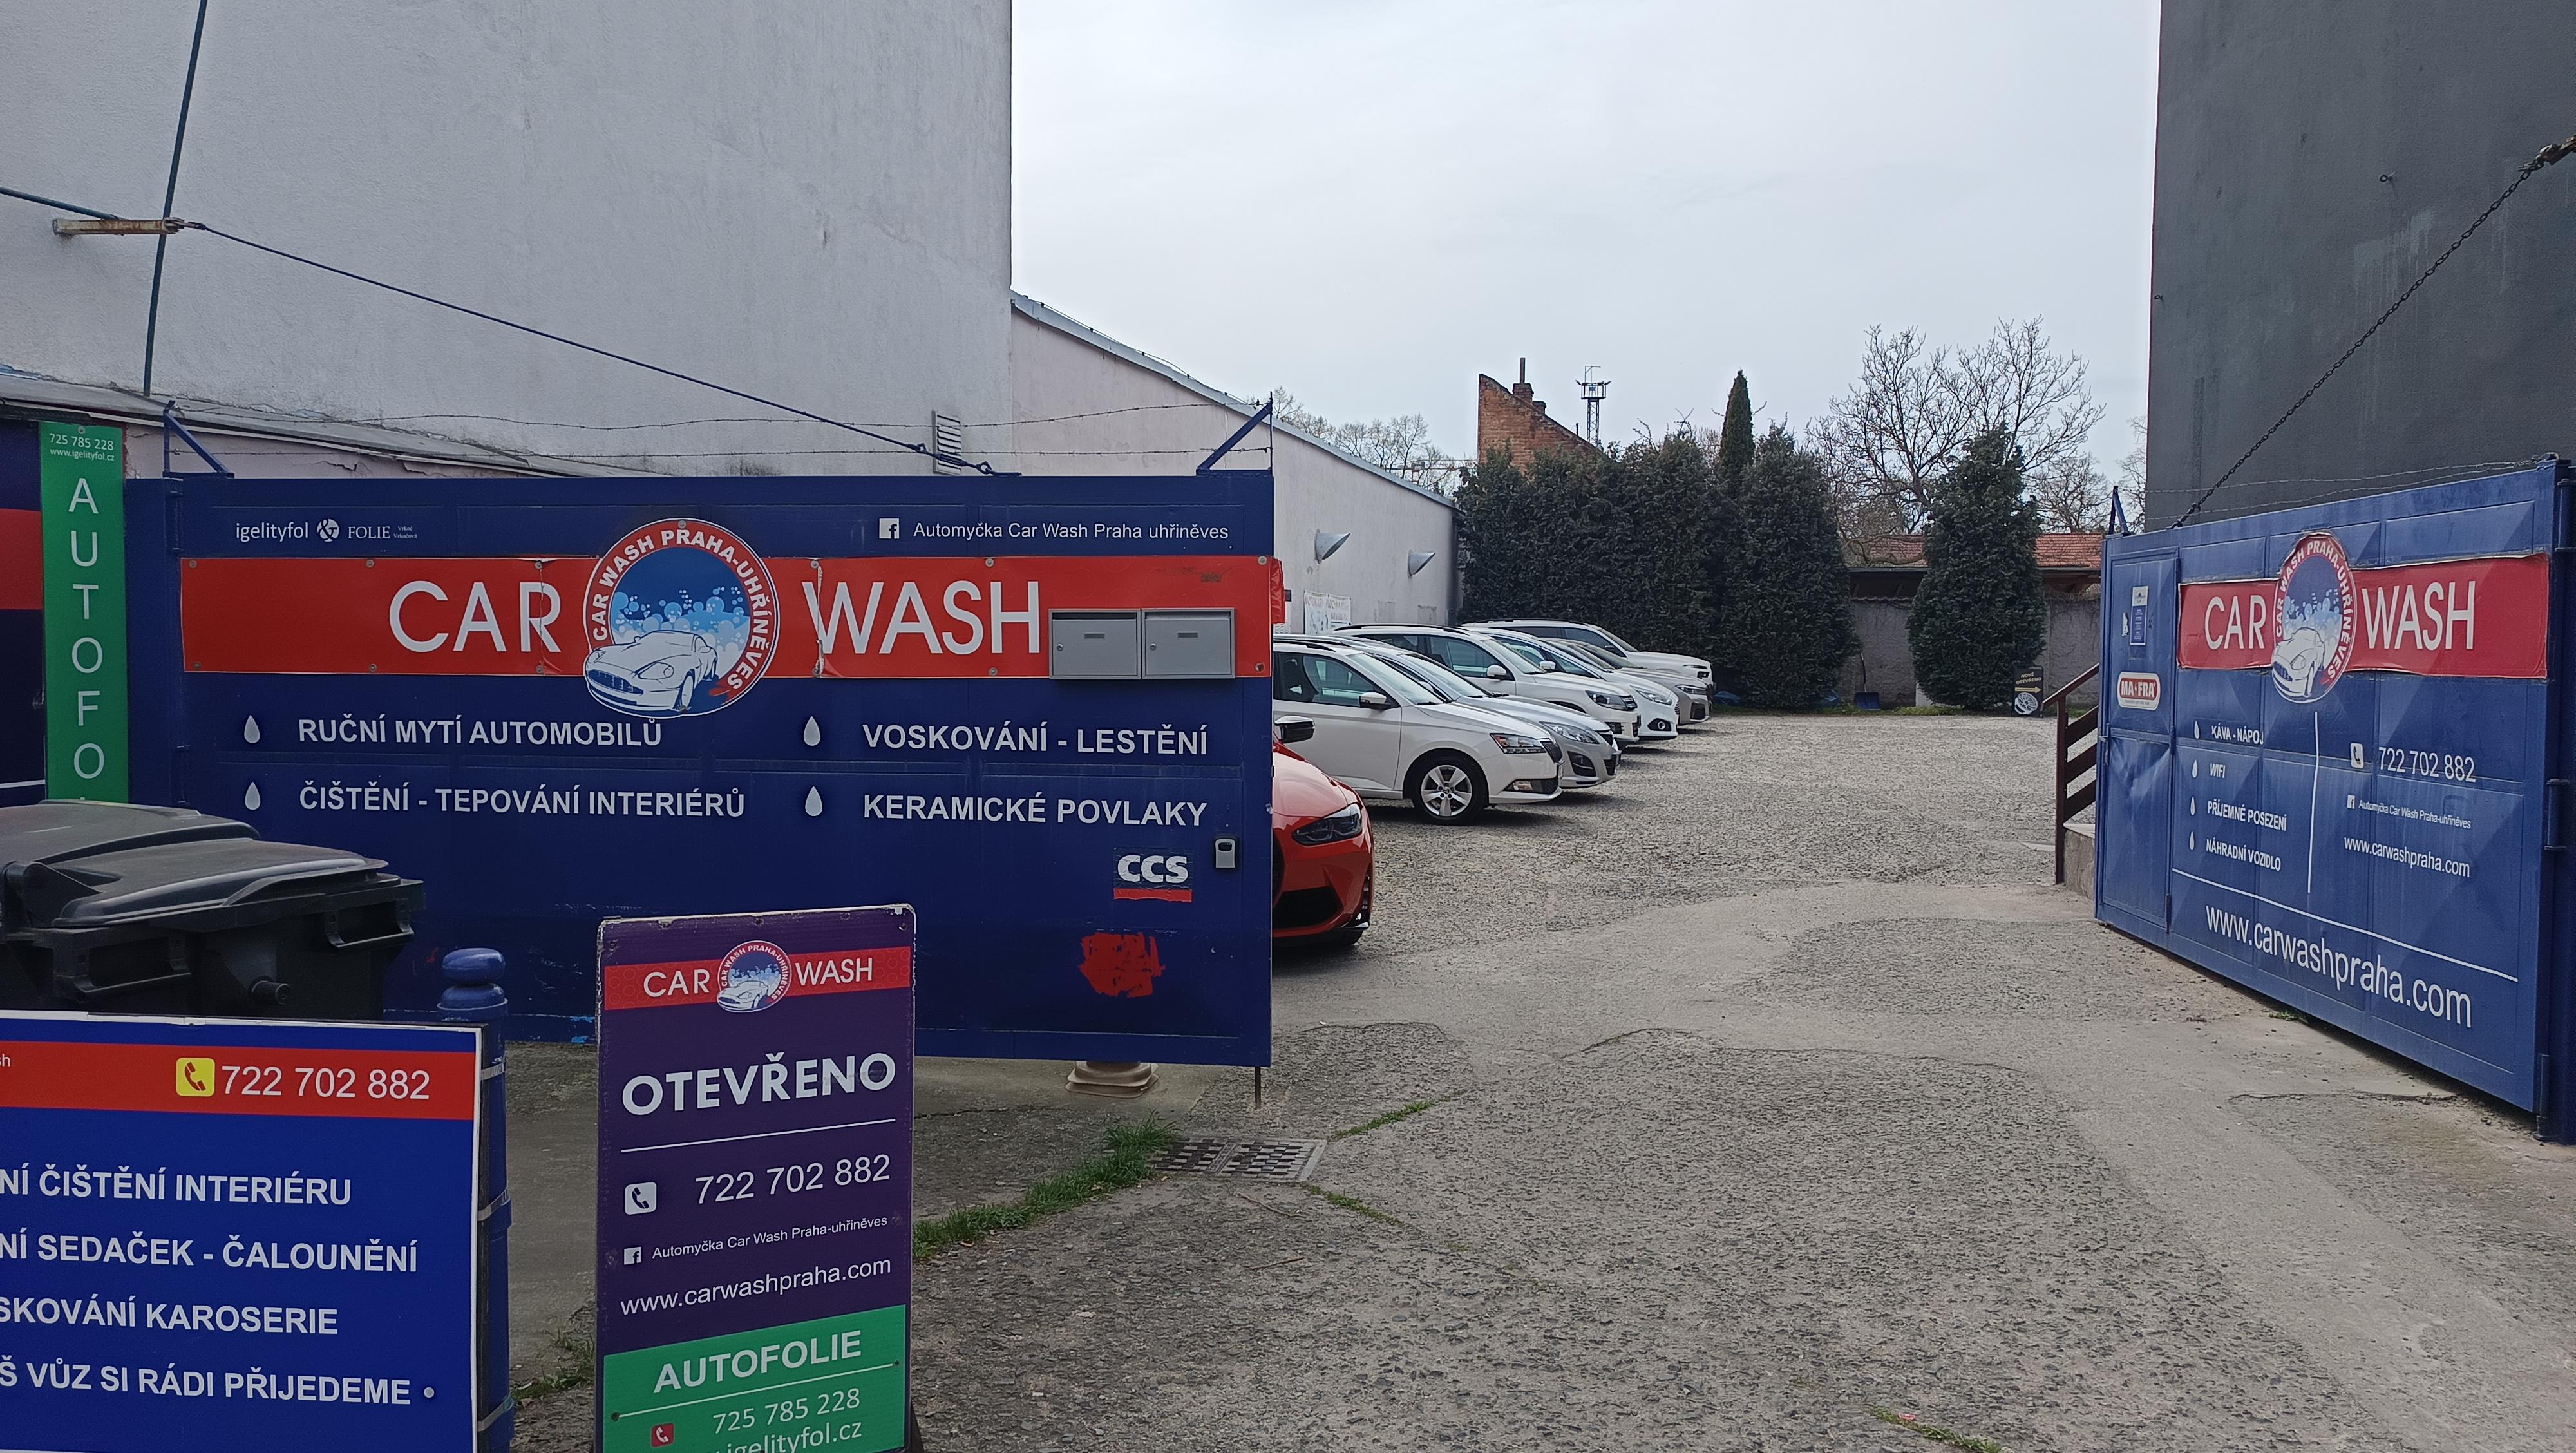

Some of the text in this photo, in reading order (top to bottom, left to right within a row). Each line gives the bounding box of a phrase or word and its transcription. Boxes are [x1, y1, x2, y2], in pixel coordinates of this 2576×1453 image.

[50, 433, 114, 451] 725 785 228
[50, 449, 115, 461] www.igelityfol.cz
[236, 522, 308, 542] igelityfol
[348, 526, 390, 539] FOLIE
[913, 522, 1003, 542] Automyčka
[1009, 523, 1037, 538] Car
[1043, 523, 1088, 539] Wash
[1094, 524, 1142, 539] Praha
[1148, 523, 1229, 540] uhřiněves
[598, 535, 654, 587] WASH
[2276, 598, 2284, 638] CAR
[2280, 547, 2304, 592] WASH
[390, 580, 562, 652] CAR
[592, 594, 609, 641] CAR
[802, 581, 1041, 654] WASH
[2204, 594, 2266, 650] CAR
[2362, 580, 2476, 651] WASH
[68, 477, 105, 801] AUTOFO
[298, 713, 662, 746] RUČNÍ MYTÍ AUTOMOBILŮ
[862, 721, 1048, 752] VOSKOVÁNÍ
[1077, 724, 1208, 755] LESTĚNÍ
[2211, 723, 2231, 740] KÁVA
[2210, 763, 2226, 778] WIFI
[2379, 746, 2476, 783] 722 702 882
[299, 780, 408, 811] ČIŠTĚNÍ
[436, 784, 580, 814] TEPOVÁNÍ
[589, 787, 745, 817] INTERIÉRŮ
[864, 792, 1208, 826] KERAMICKÉ POVLAKY
[2208, 799, 2287, 831] PŘÍJEMNÉ POSEZENÍ
[2358, 799, 2389, 814] Automyčka
[2389, 804, 2400, 815] Car
[2401, 806, 2418, 819] Wash
[1117, 853, 1188, 884] CCS
[2206, 837, 2282, 871] NÁHRADNÍ VOZIDLO
[2344, 837, 2470, 878] www.carwashpraha.com
[724, 947, 746, 968] WASH
[795, 958, 874, 985] WASH
[2206, 906, 2472, 1028] www.carwashpraha.com
[643, 969, 710, 998] CAR
[222, 1065, 430, 1100] 722 702 882
[622, 1052, 896, 1116] OTEVŘENO
[39, 1163, 166, 1200] ČIŠTĚNÍ
[176, 1171, 351, 1205] INTERIÉRU
[695, 1154, 890, 1204] 722 702 882
[37, 1231, 194, 1266] SEDAČEK
[223, 1234, 417, 1272] ČALOUNĚNÍ
[652, 1239, 723, 1259] Automyčka
[727, 1235, 750, 1248] Car
[753, 1230, 788, 1244] Wash
[791, 1216, 887, 1240] Praha-uhřiněves
[620, 1258, 891, 1315] www.carwashpraha.com
[146, 1303, 338, 1334] KAROSERIE
[653, 1330, 862, 1394] AUTOFOLIE
[26, 1358, 91, 1389] VŮZ
[100, 1365, 128, 1392] SI
[139, 1363, 213, 1397] RÁDI
[225, 1367, 411, 1405] PŘIJEDEME
[713, 1388, 860, 1434] 725 785 228
